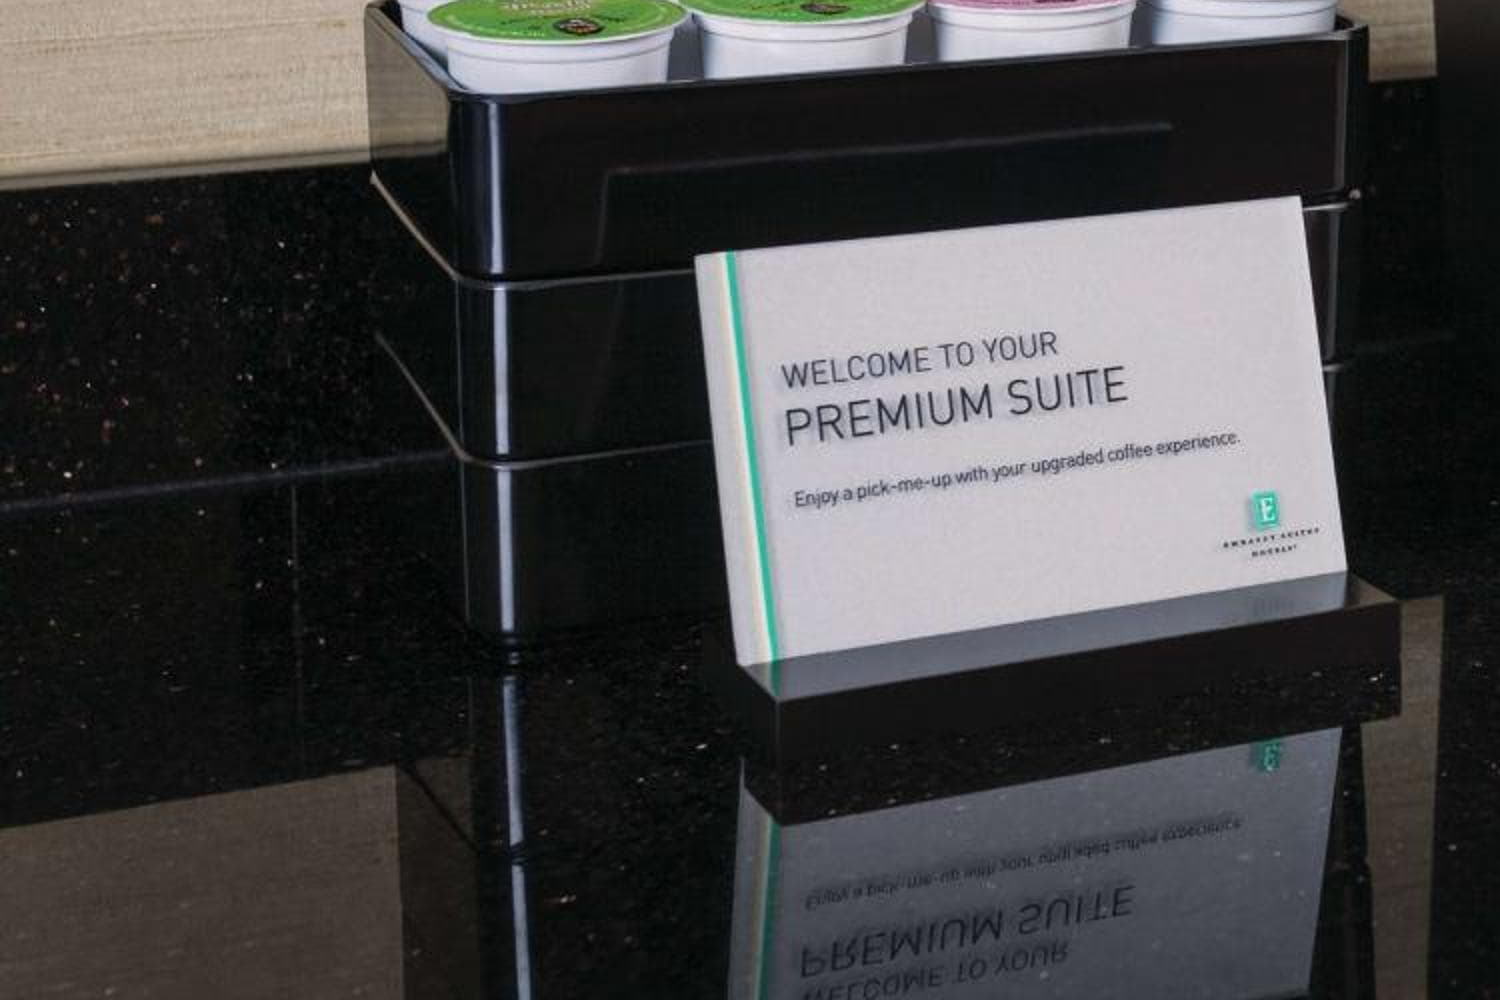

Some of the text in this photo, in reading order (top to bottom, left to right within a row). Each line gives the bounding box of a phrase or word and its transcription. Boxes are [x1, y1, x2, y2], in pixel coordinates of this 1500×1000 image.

[781, 330, 1058, 389] WELCOME TO YOUR
[785, 365, 1129, 447] PREMIUM SUITE
[794, 431, 1241, 509] Enjoy a pick-me-up with your upgraded coffee experience.
